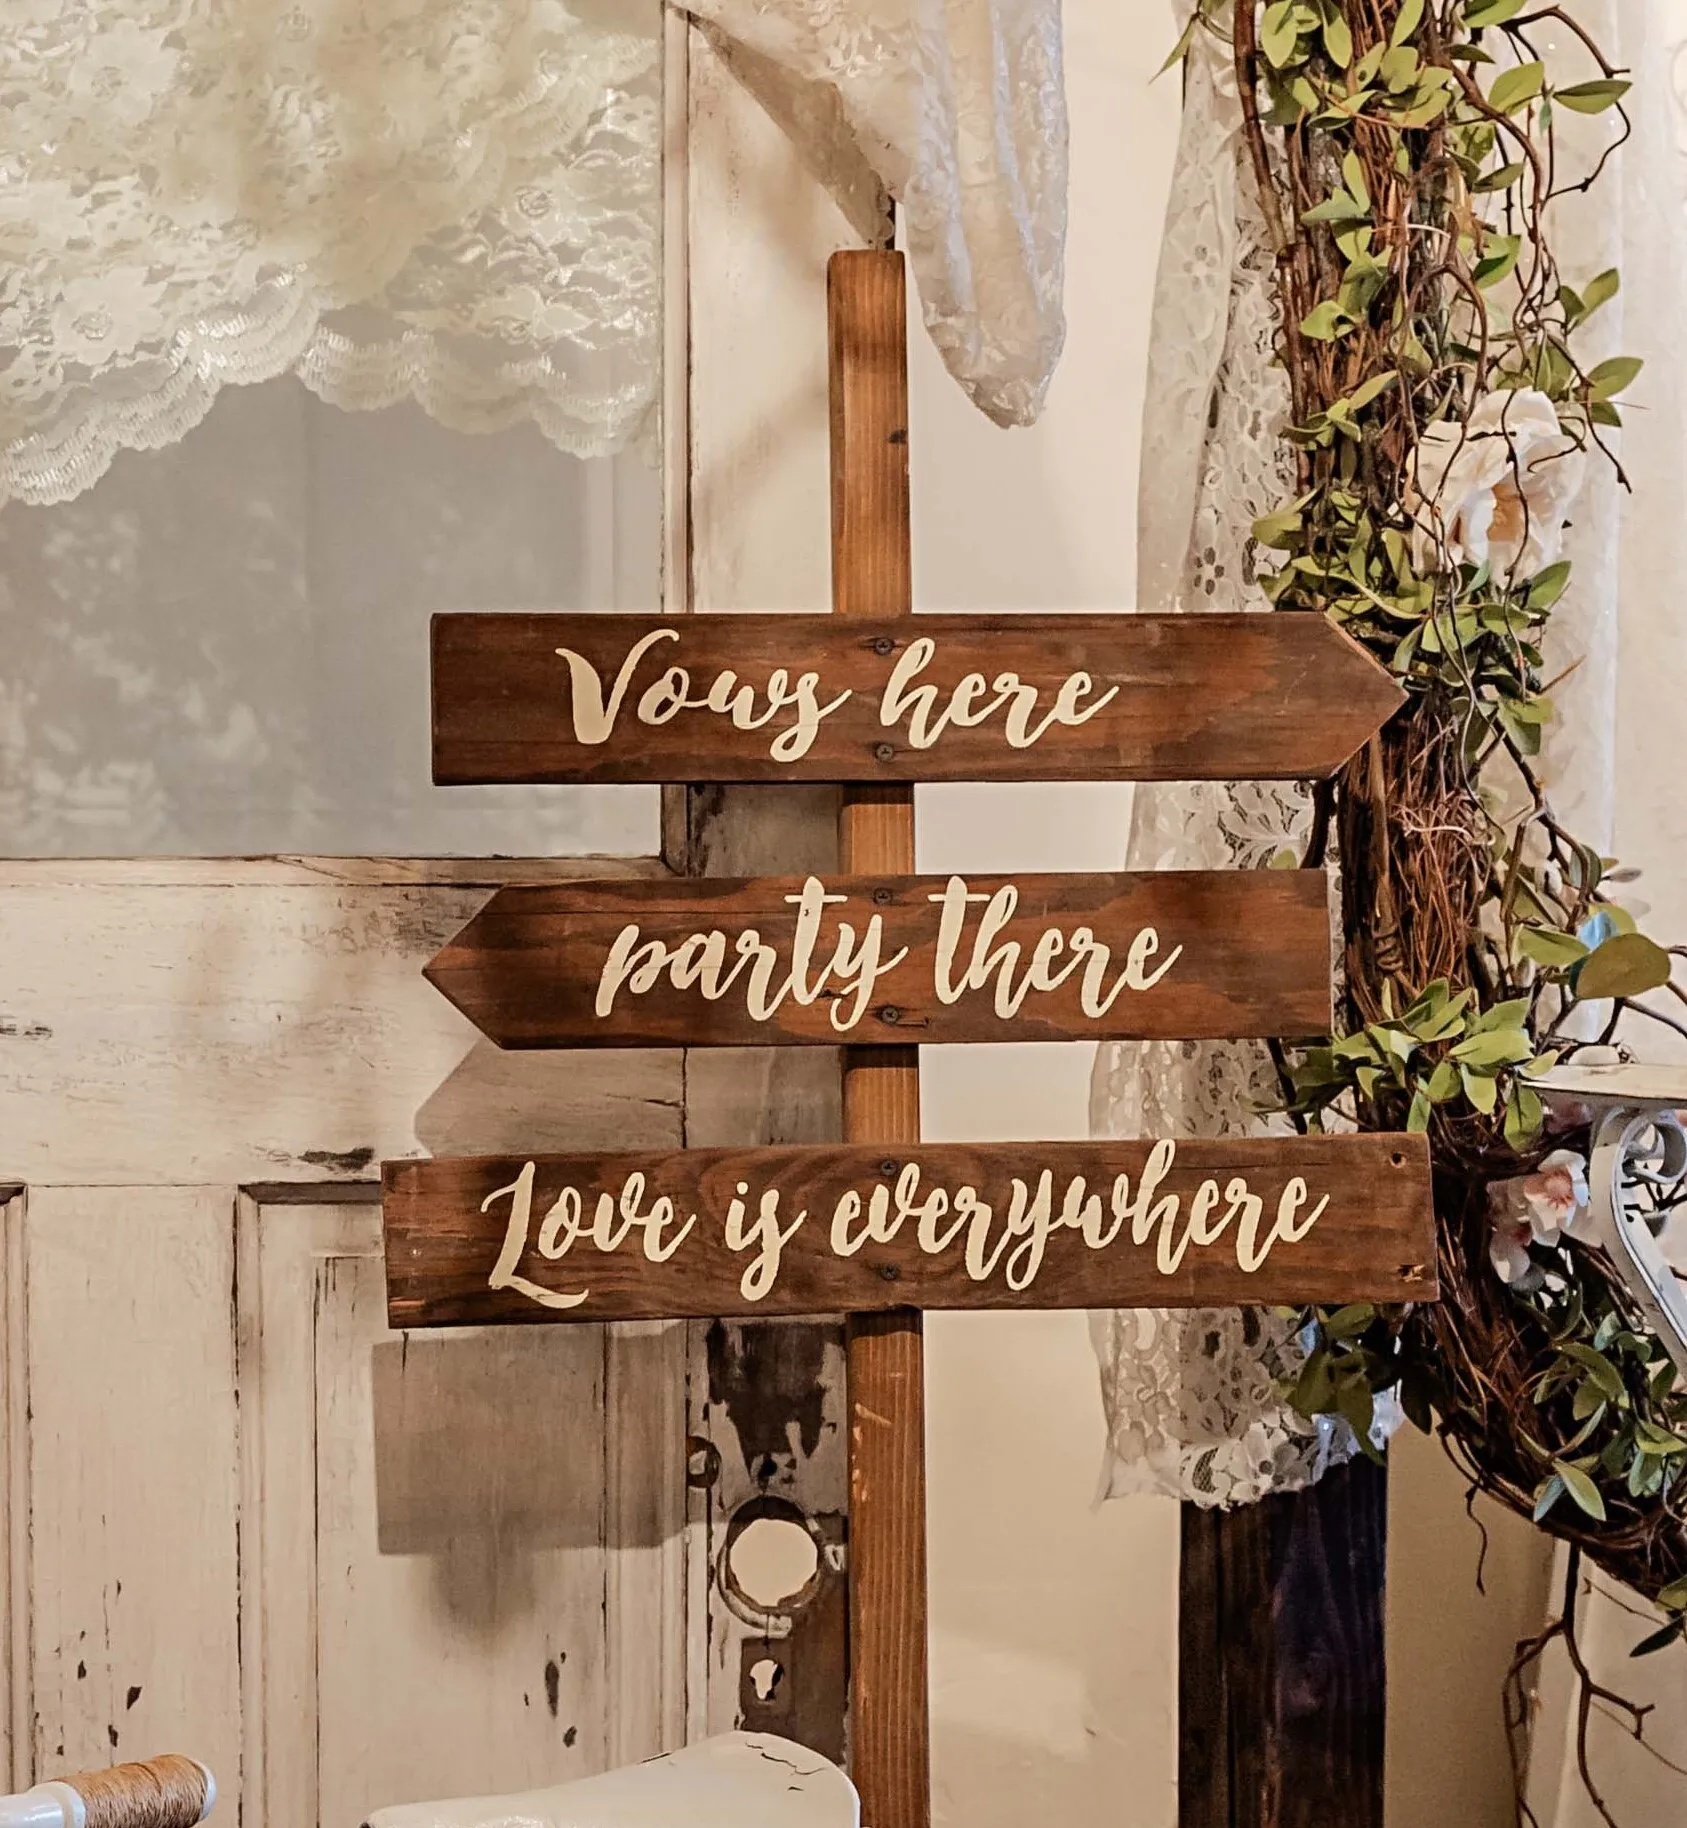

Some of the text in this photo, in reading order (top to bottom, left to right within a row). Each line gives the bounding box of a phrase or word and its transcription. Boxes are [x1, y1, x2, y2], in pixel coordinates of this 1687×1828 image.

[556, 629, 1119, 761] Vows here
[596, 875, 1182, 1031] party there
[481, 1137, 1329, 1308] Love is everywhere
